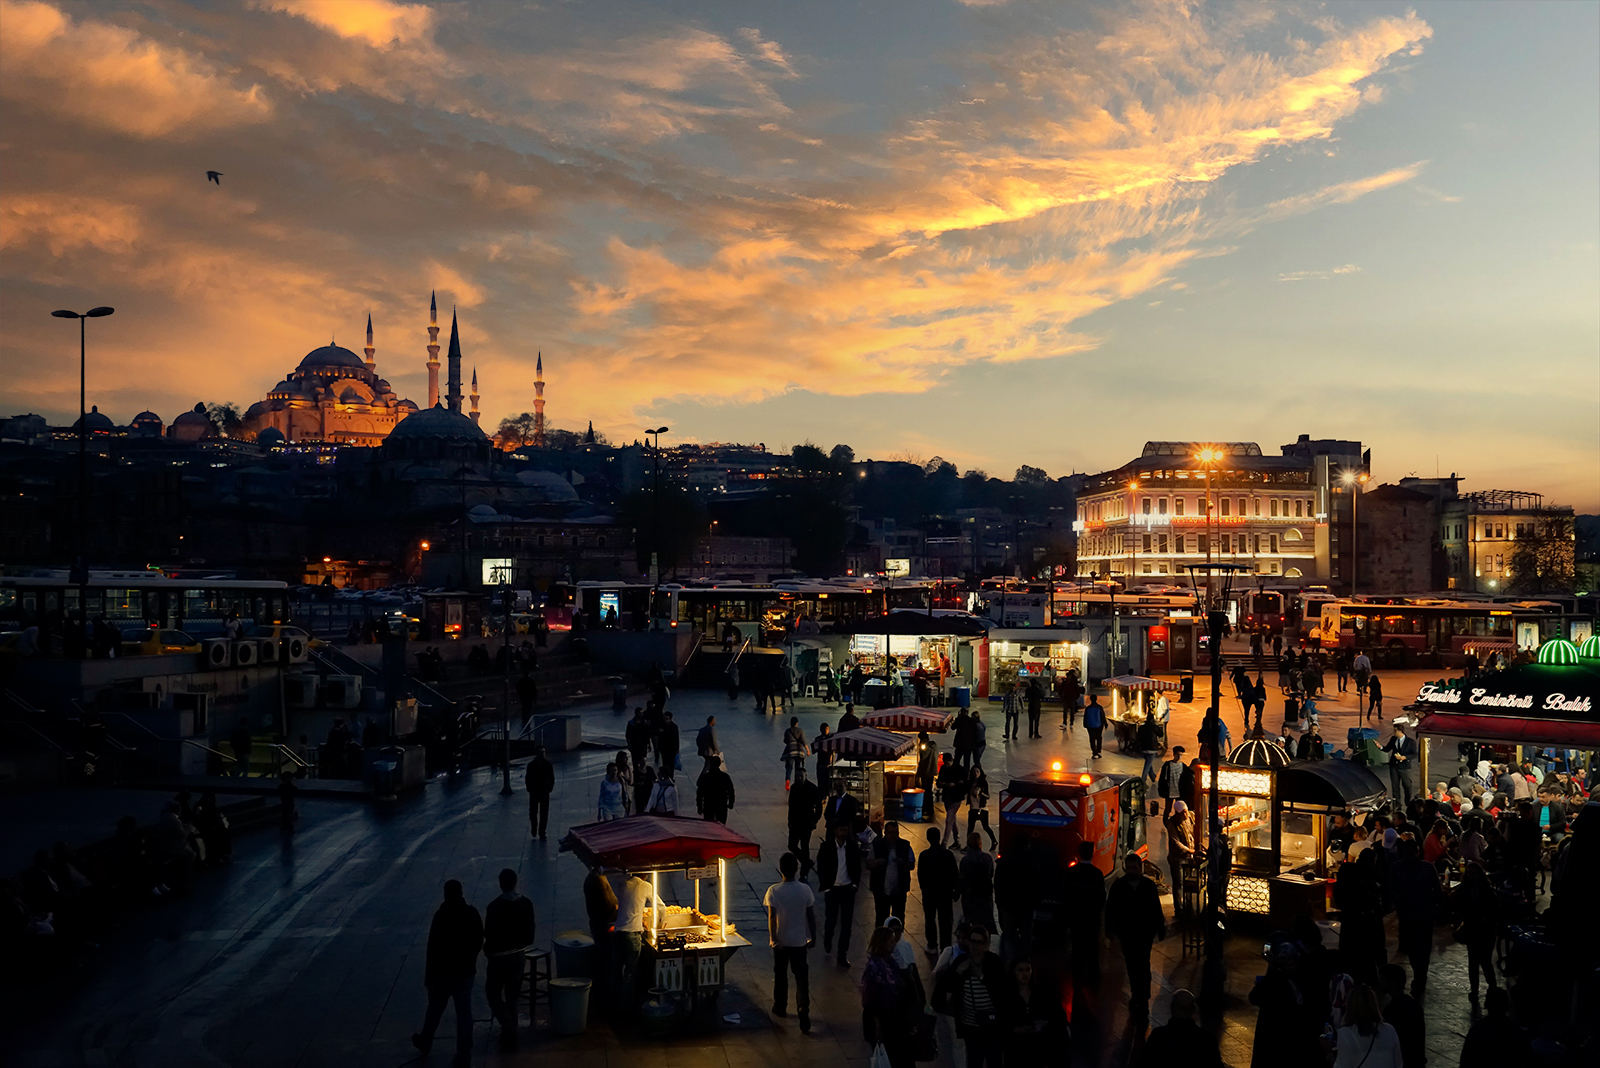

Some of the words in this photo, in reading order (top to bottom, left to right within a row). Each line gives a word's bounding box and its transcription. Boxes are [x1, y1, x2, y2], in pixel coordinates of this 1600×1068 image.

[1129, 506, 1169, 531] surplus
[1416, 685, 1461, 703] Tarihi
[1470, 688, 1533, 708] Eminönü
[1542, 694, 1591, 711] Balık
